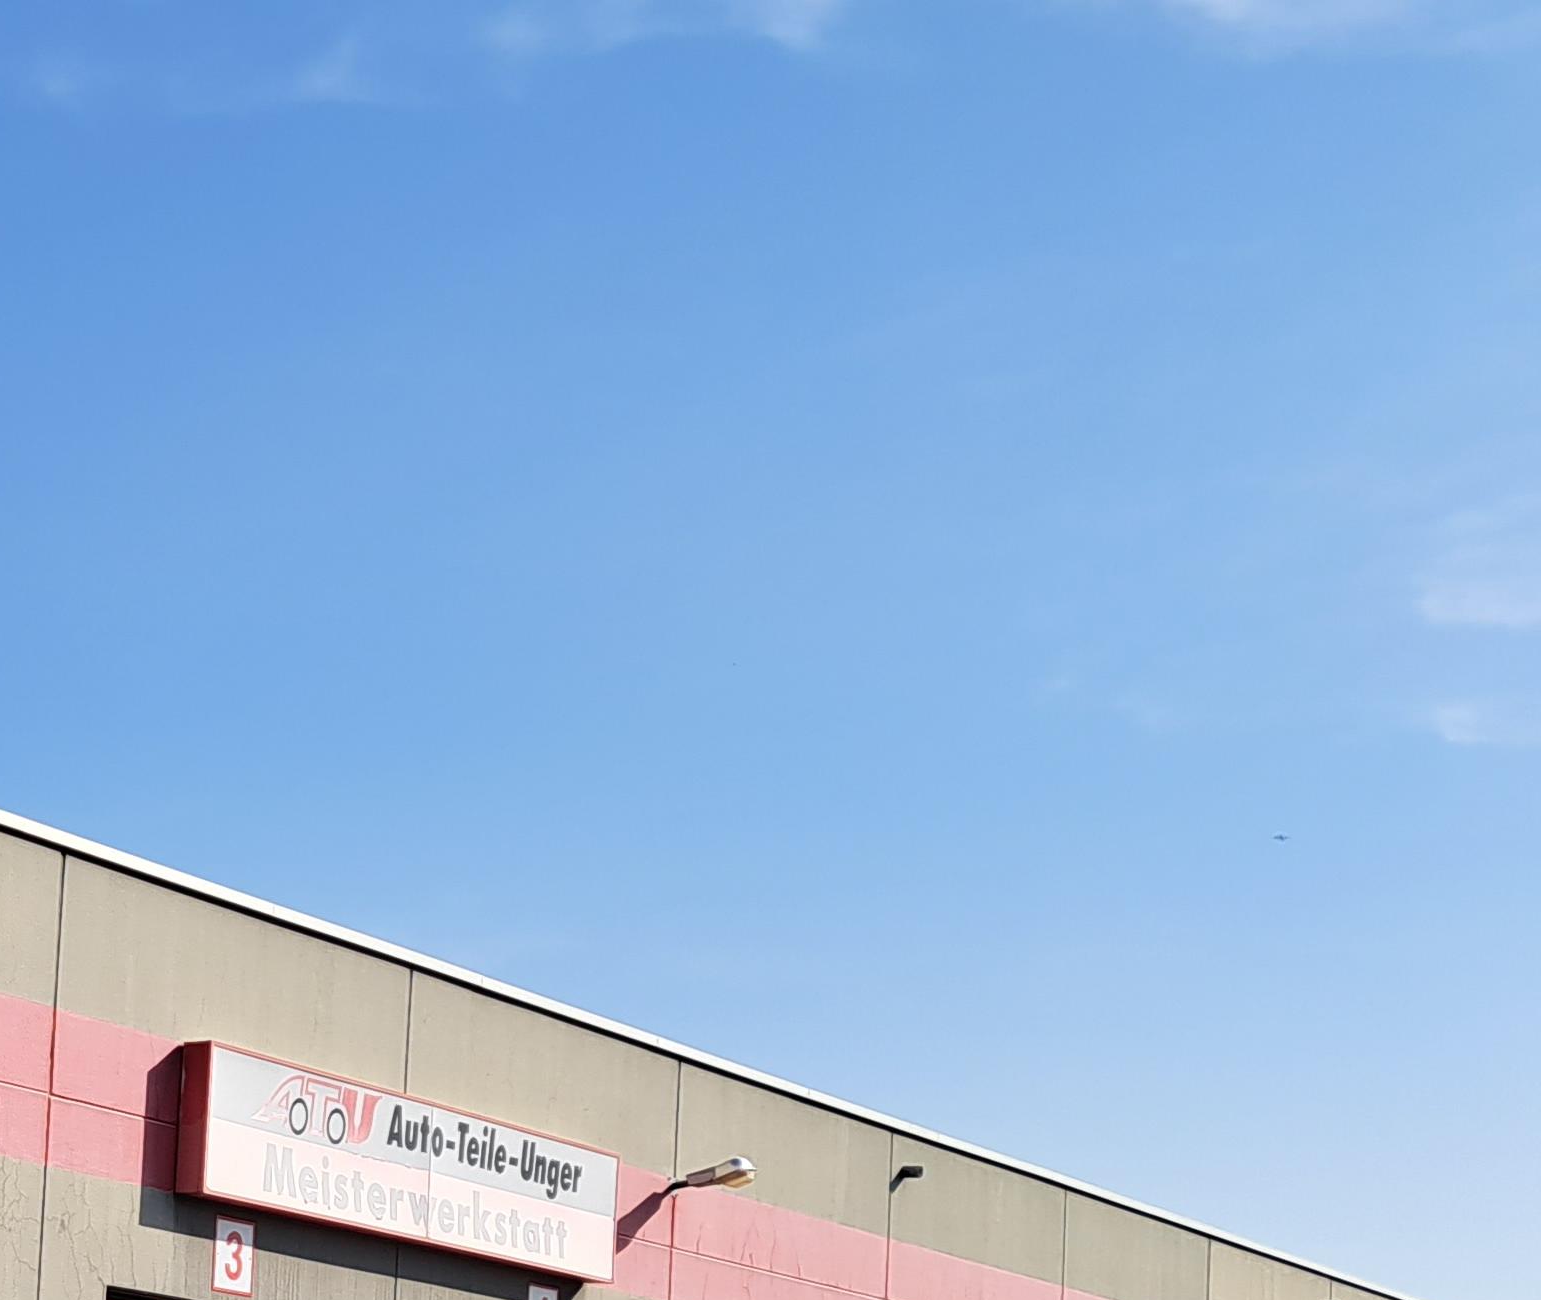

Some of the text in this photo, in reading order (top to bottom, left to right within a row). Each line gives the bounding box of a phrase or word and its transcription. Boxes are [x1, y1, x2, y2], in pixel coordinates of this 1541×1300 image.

[387, 1105, 582, 1200] Auto-Teile-Unger
[262, 1142, 568, 1259] Meisterwerkstatt
[223, 1230, 243, 1281] 3
